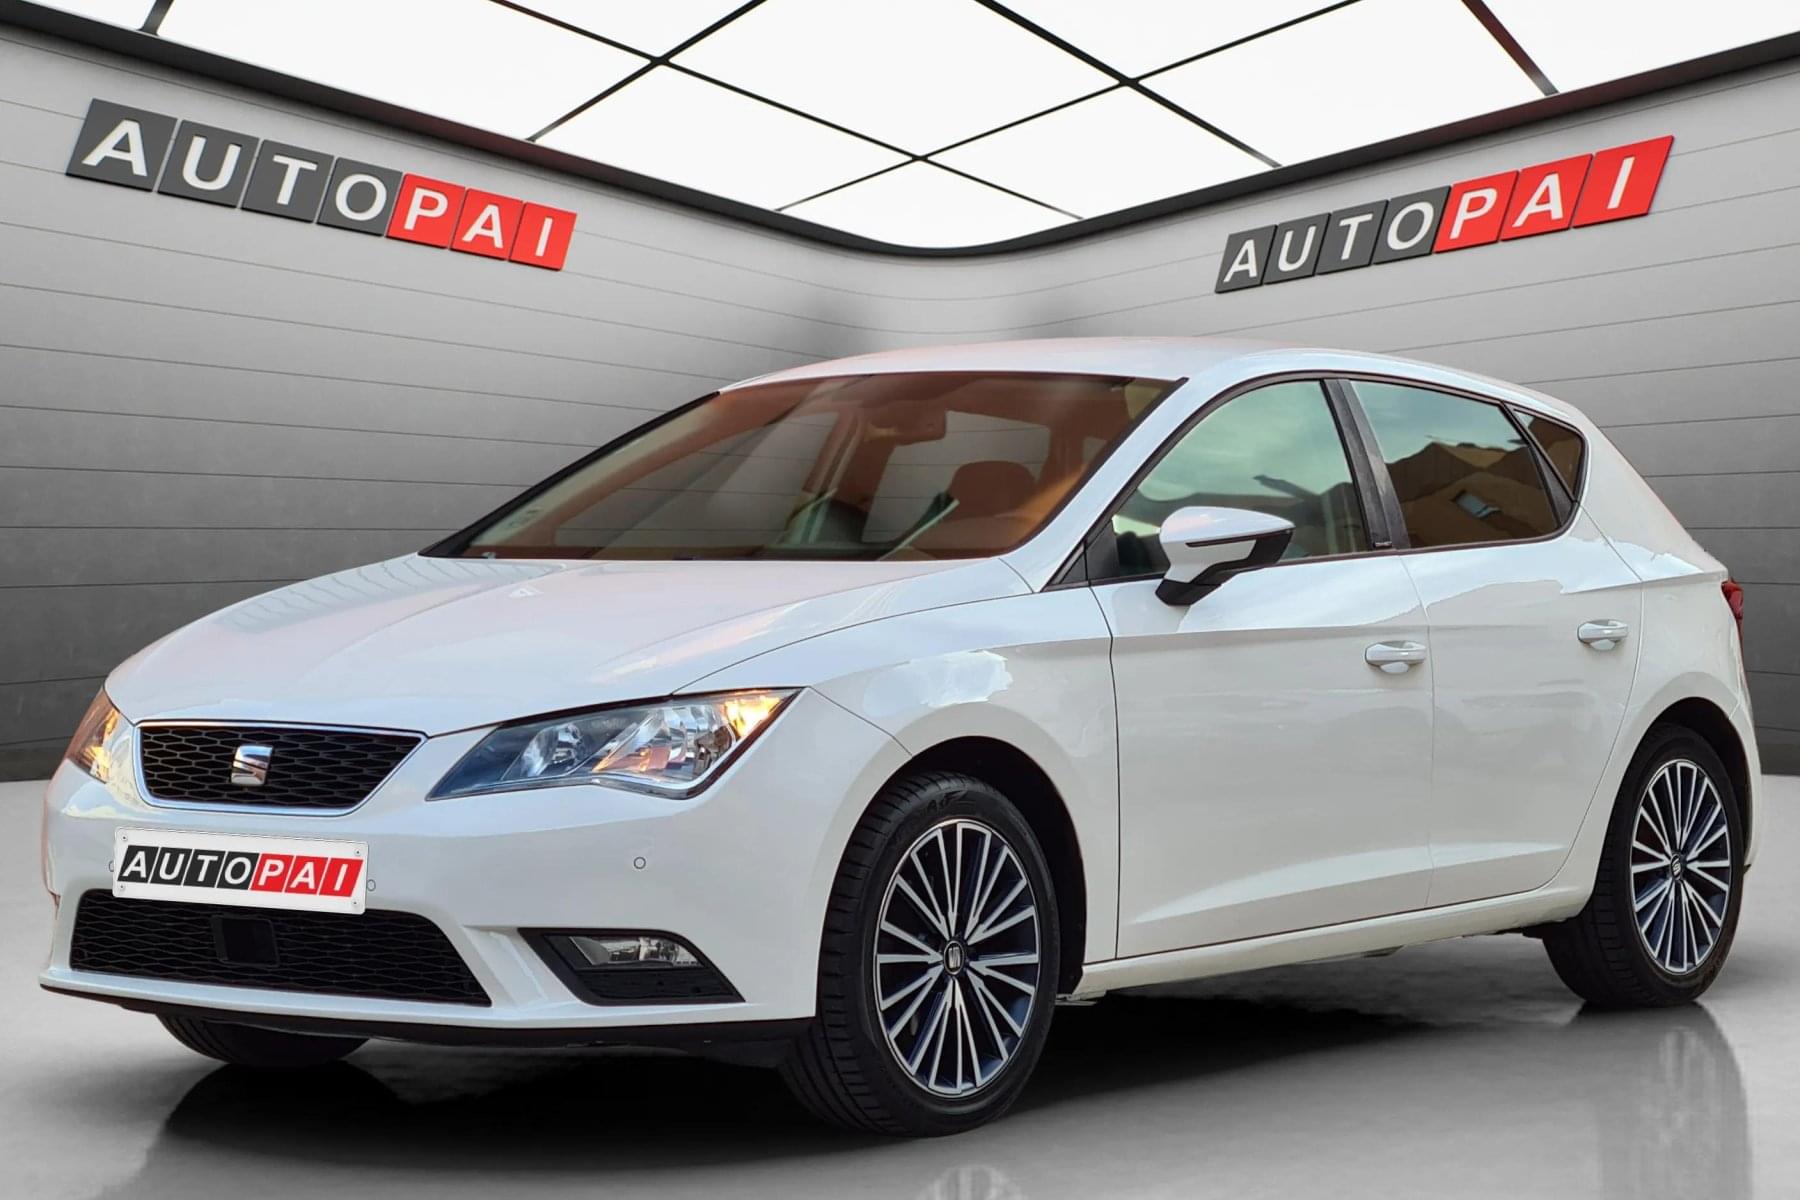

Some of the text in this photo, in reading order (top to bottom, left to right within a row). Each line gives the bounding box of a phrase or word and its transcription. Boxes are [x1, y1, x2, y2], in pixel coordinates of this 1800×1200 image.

[82, 119, 554, 258] AUTOPAI
[1222, 157, 1635, 284] AUTOPAI
[122, 849, 349, 892] AUTOPAI
